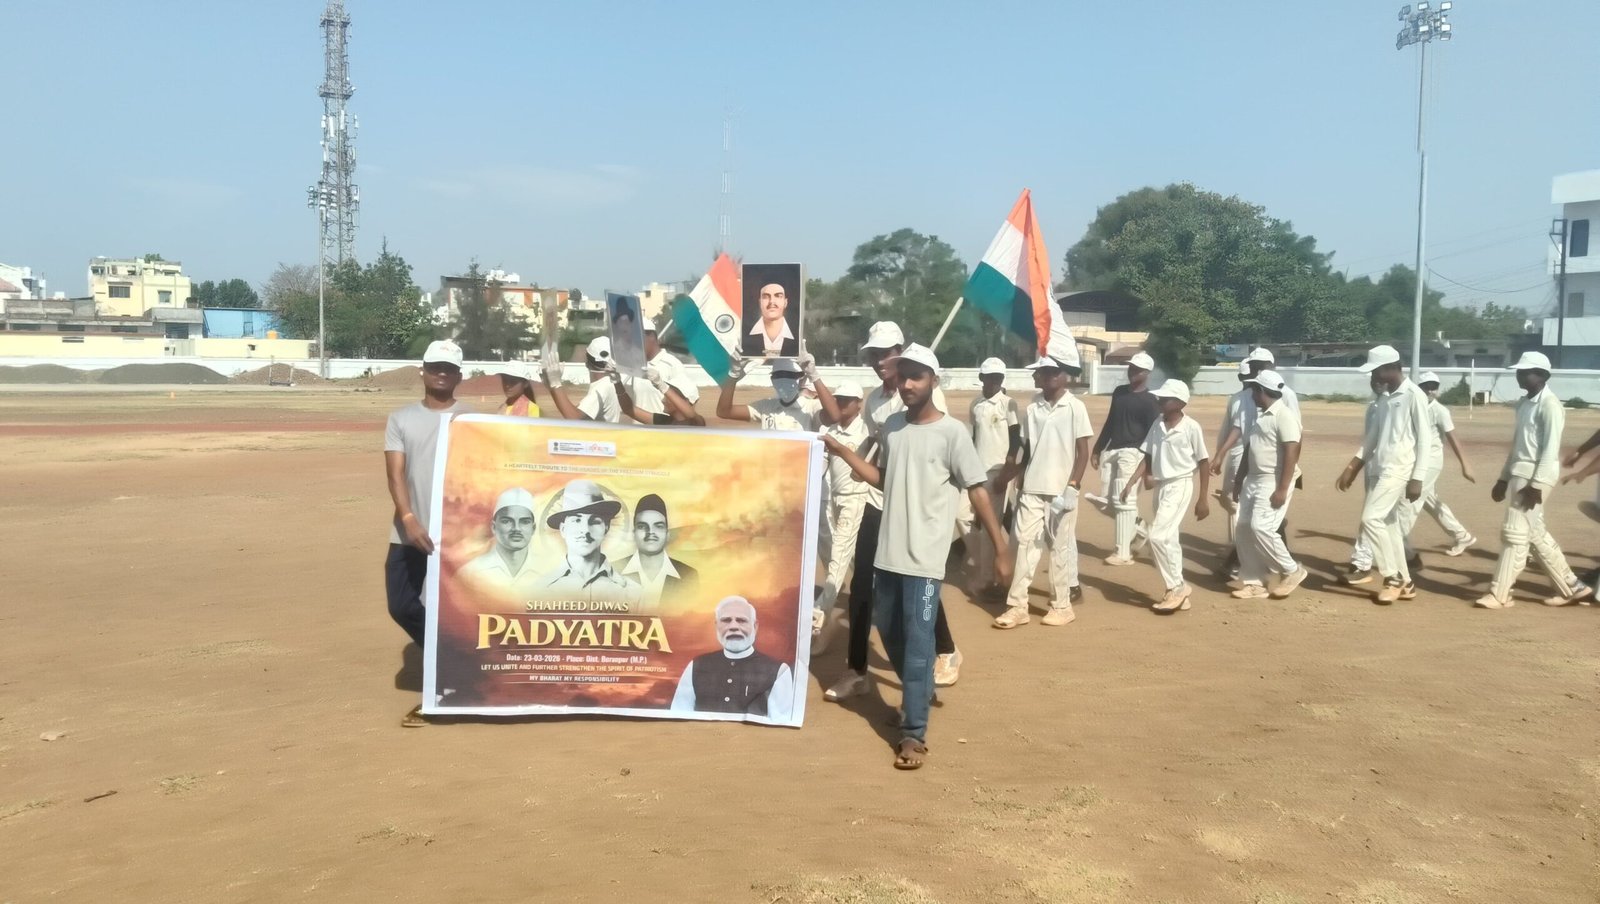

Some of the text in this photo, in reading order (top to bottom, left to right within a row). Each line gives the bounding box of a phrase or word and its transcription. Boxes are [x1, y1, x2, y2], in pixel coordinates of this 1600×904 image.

[526, 600, 629, 612] SHAHEED DIWAS
[476, 613, 672, 653] PADYATRA
[506, 654, 522, 662] Date:
[566, 655, 584, 663] Place:
[630, 656, 648, 664] (M.P.)
